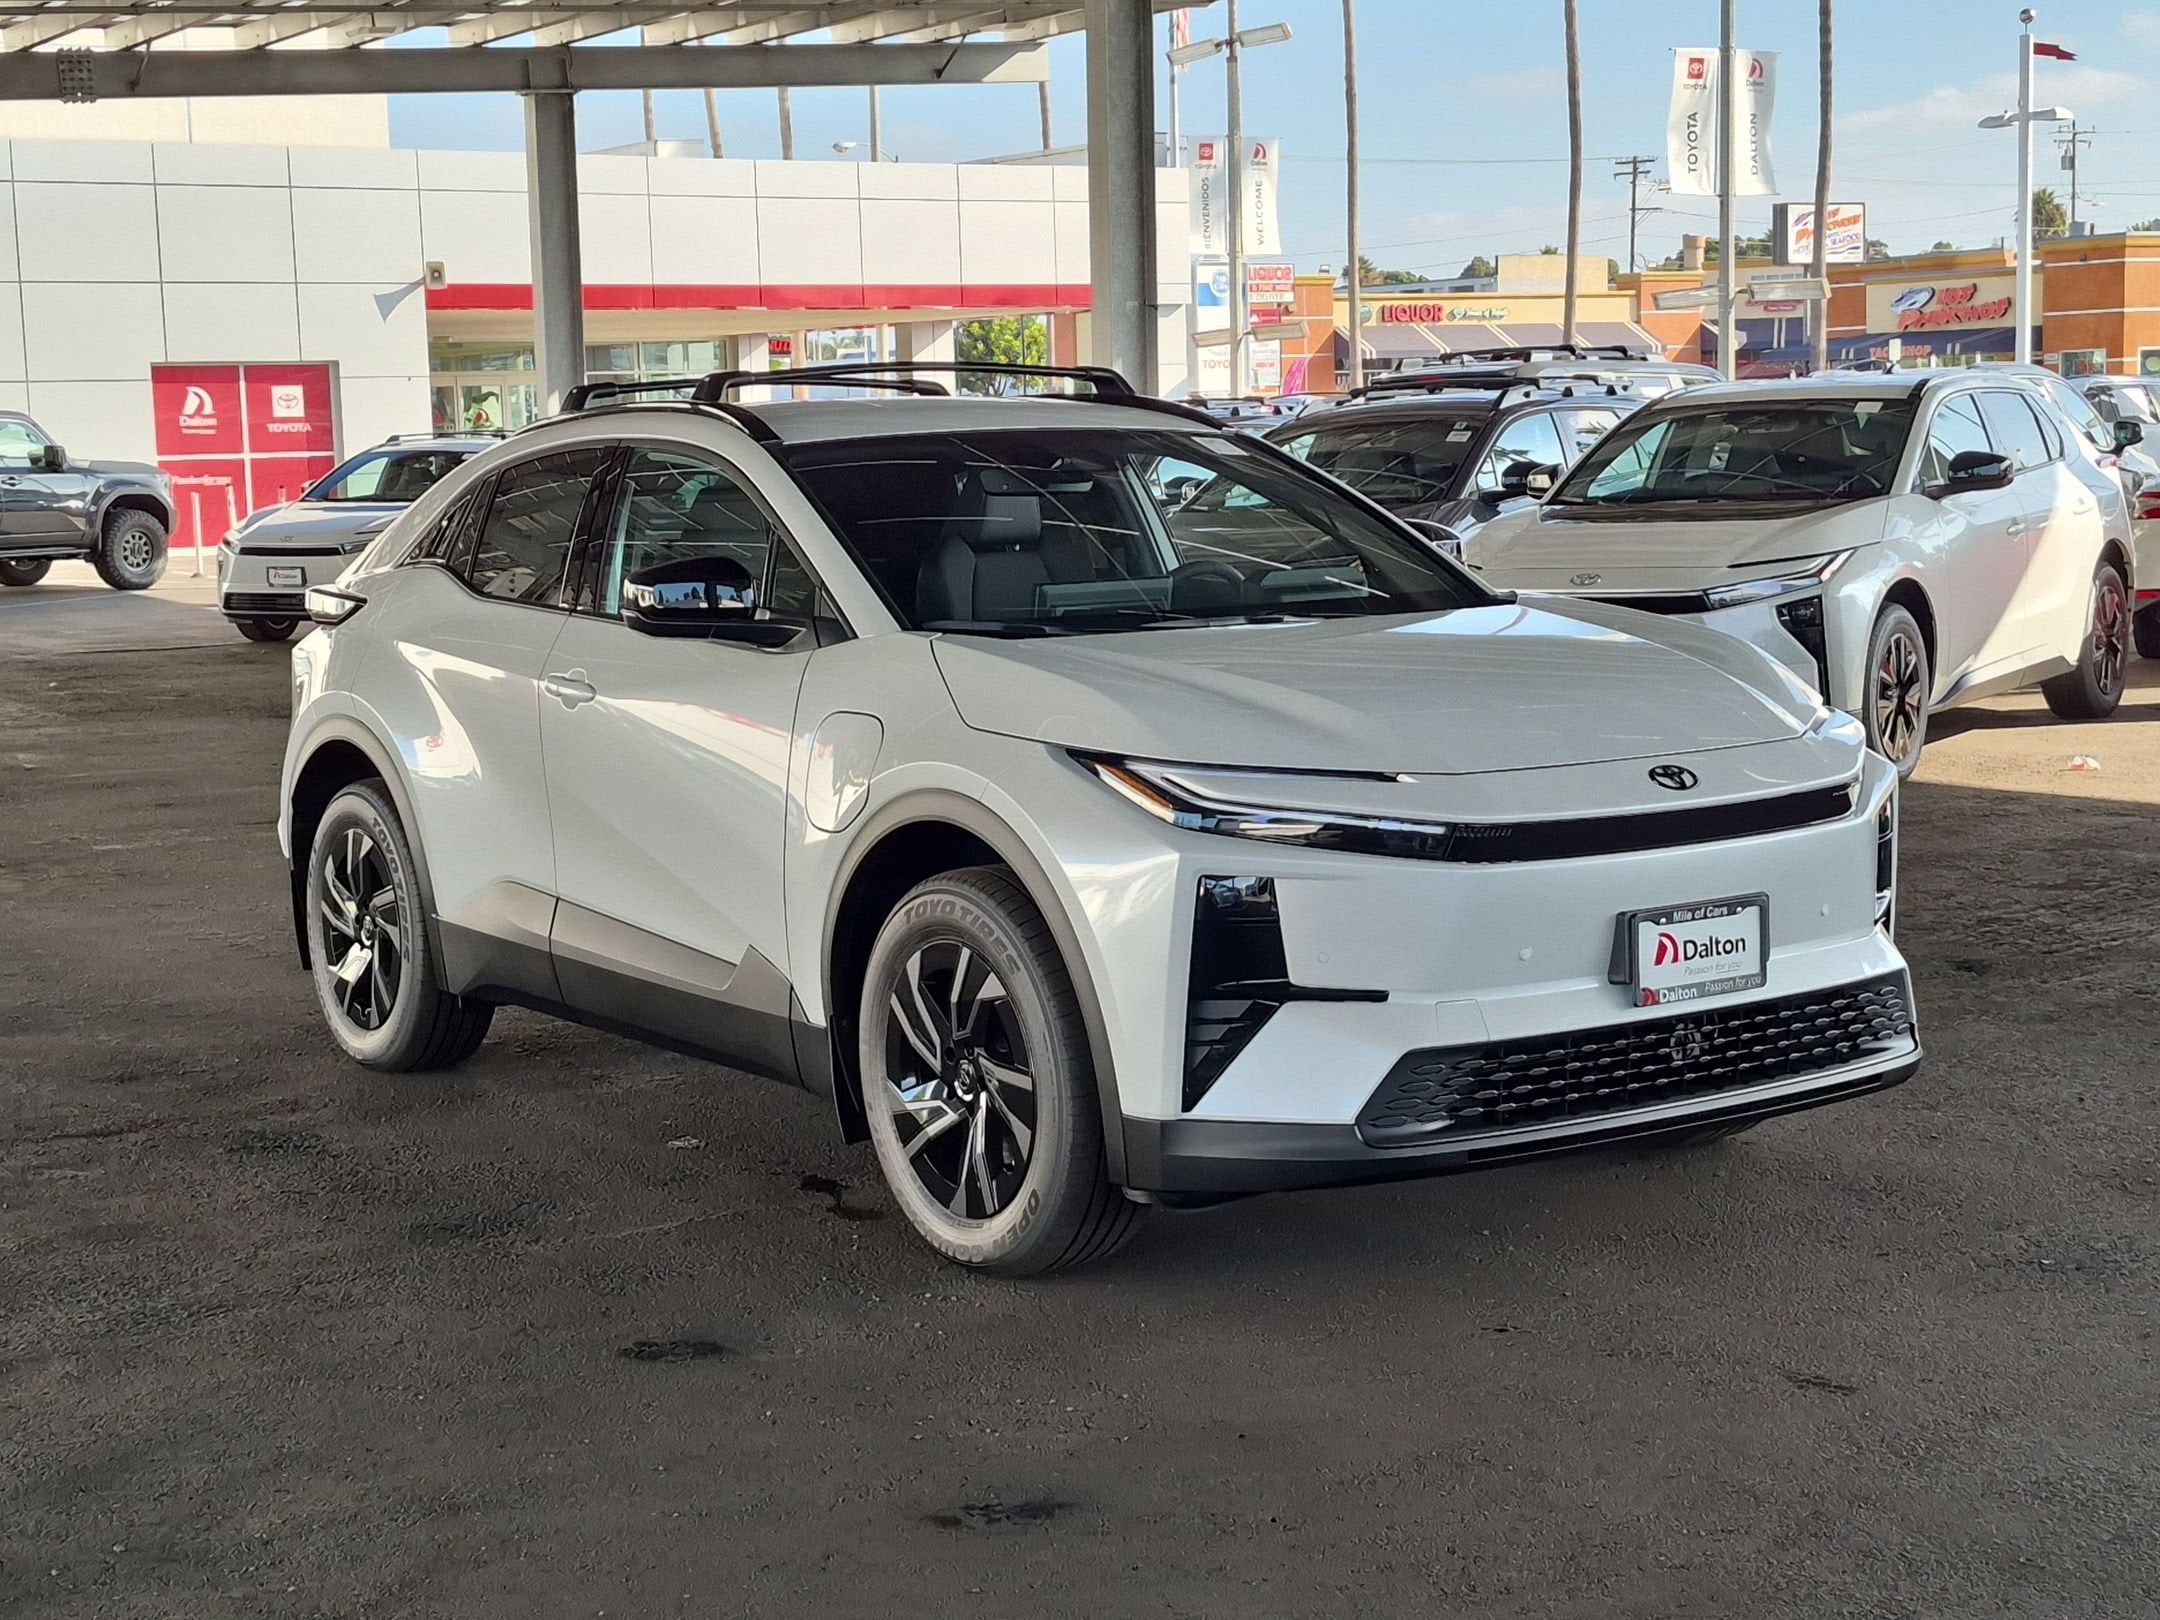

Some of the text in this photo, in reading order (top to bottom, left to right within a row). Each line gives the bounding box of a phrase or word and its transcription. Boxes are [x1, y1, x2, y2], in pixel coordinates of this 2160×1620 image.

[1687, 111, 1698, 174] TOYOTA
[1750, 113, 1758, 175] DALTON
[1255, 180, 1265, 246] WELCOME
[1382, 303, 1443, 323] LIQUOR
[1203, 359, 1231, 369] TOYO
[1869, 347, 1889, 357] TAC
[266, 422, 312, 433] TOYOTA
[372, 816, 399, 875] TOYO
[903, 898, 957, 926] TOYO
[1672, 905, 1728, 923] Mile of Cars
[959, 904, 1021, 976] TIRES
[1683, 935, 1746, 961] Dalton
[1684, 960, 1744, 977] Passion for you
[1659, 974, 1762, 1004] Dalton Passion for you
[992, 1188, 1041, 1251] OPEN
